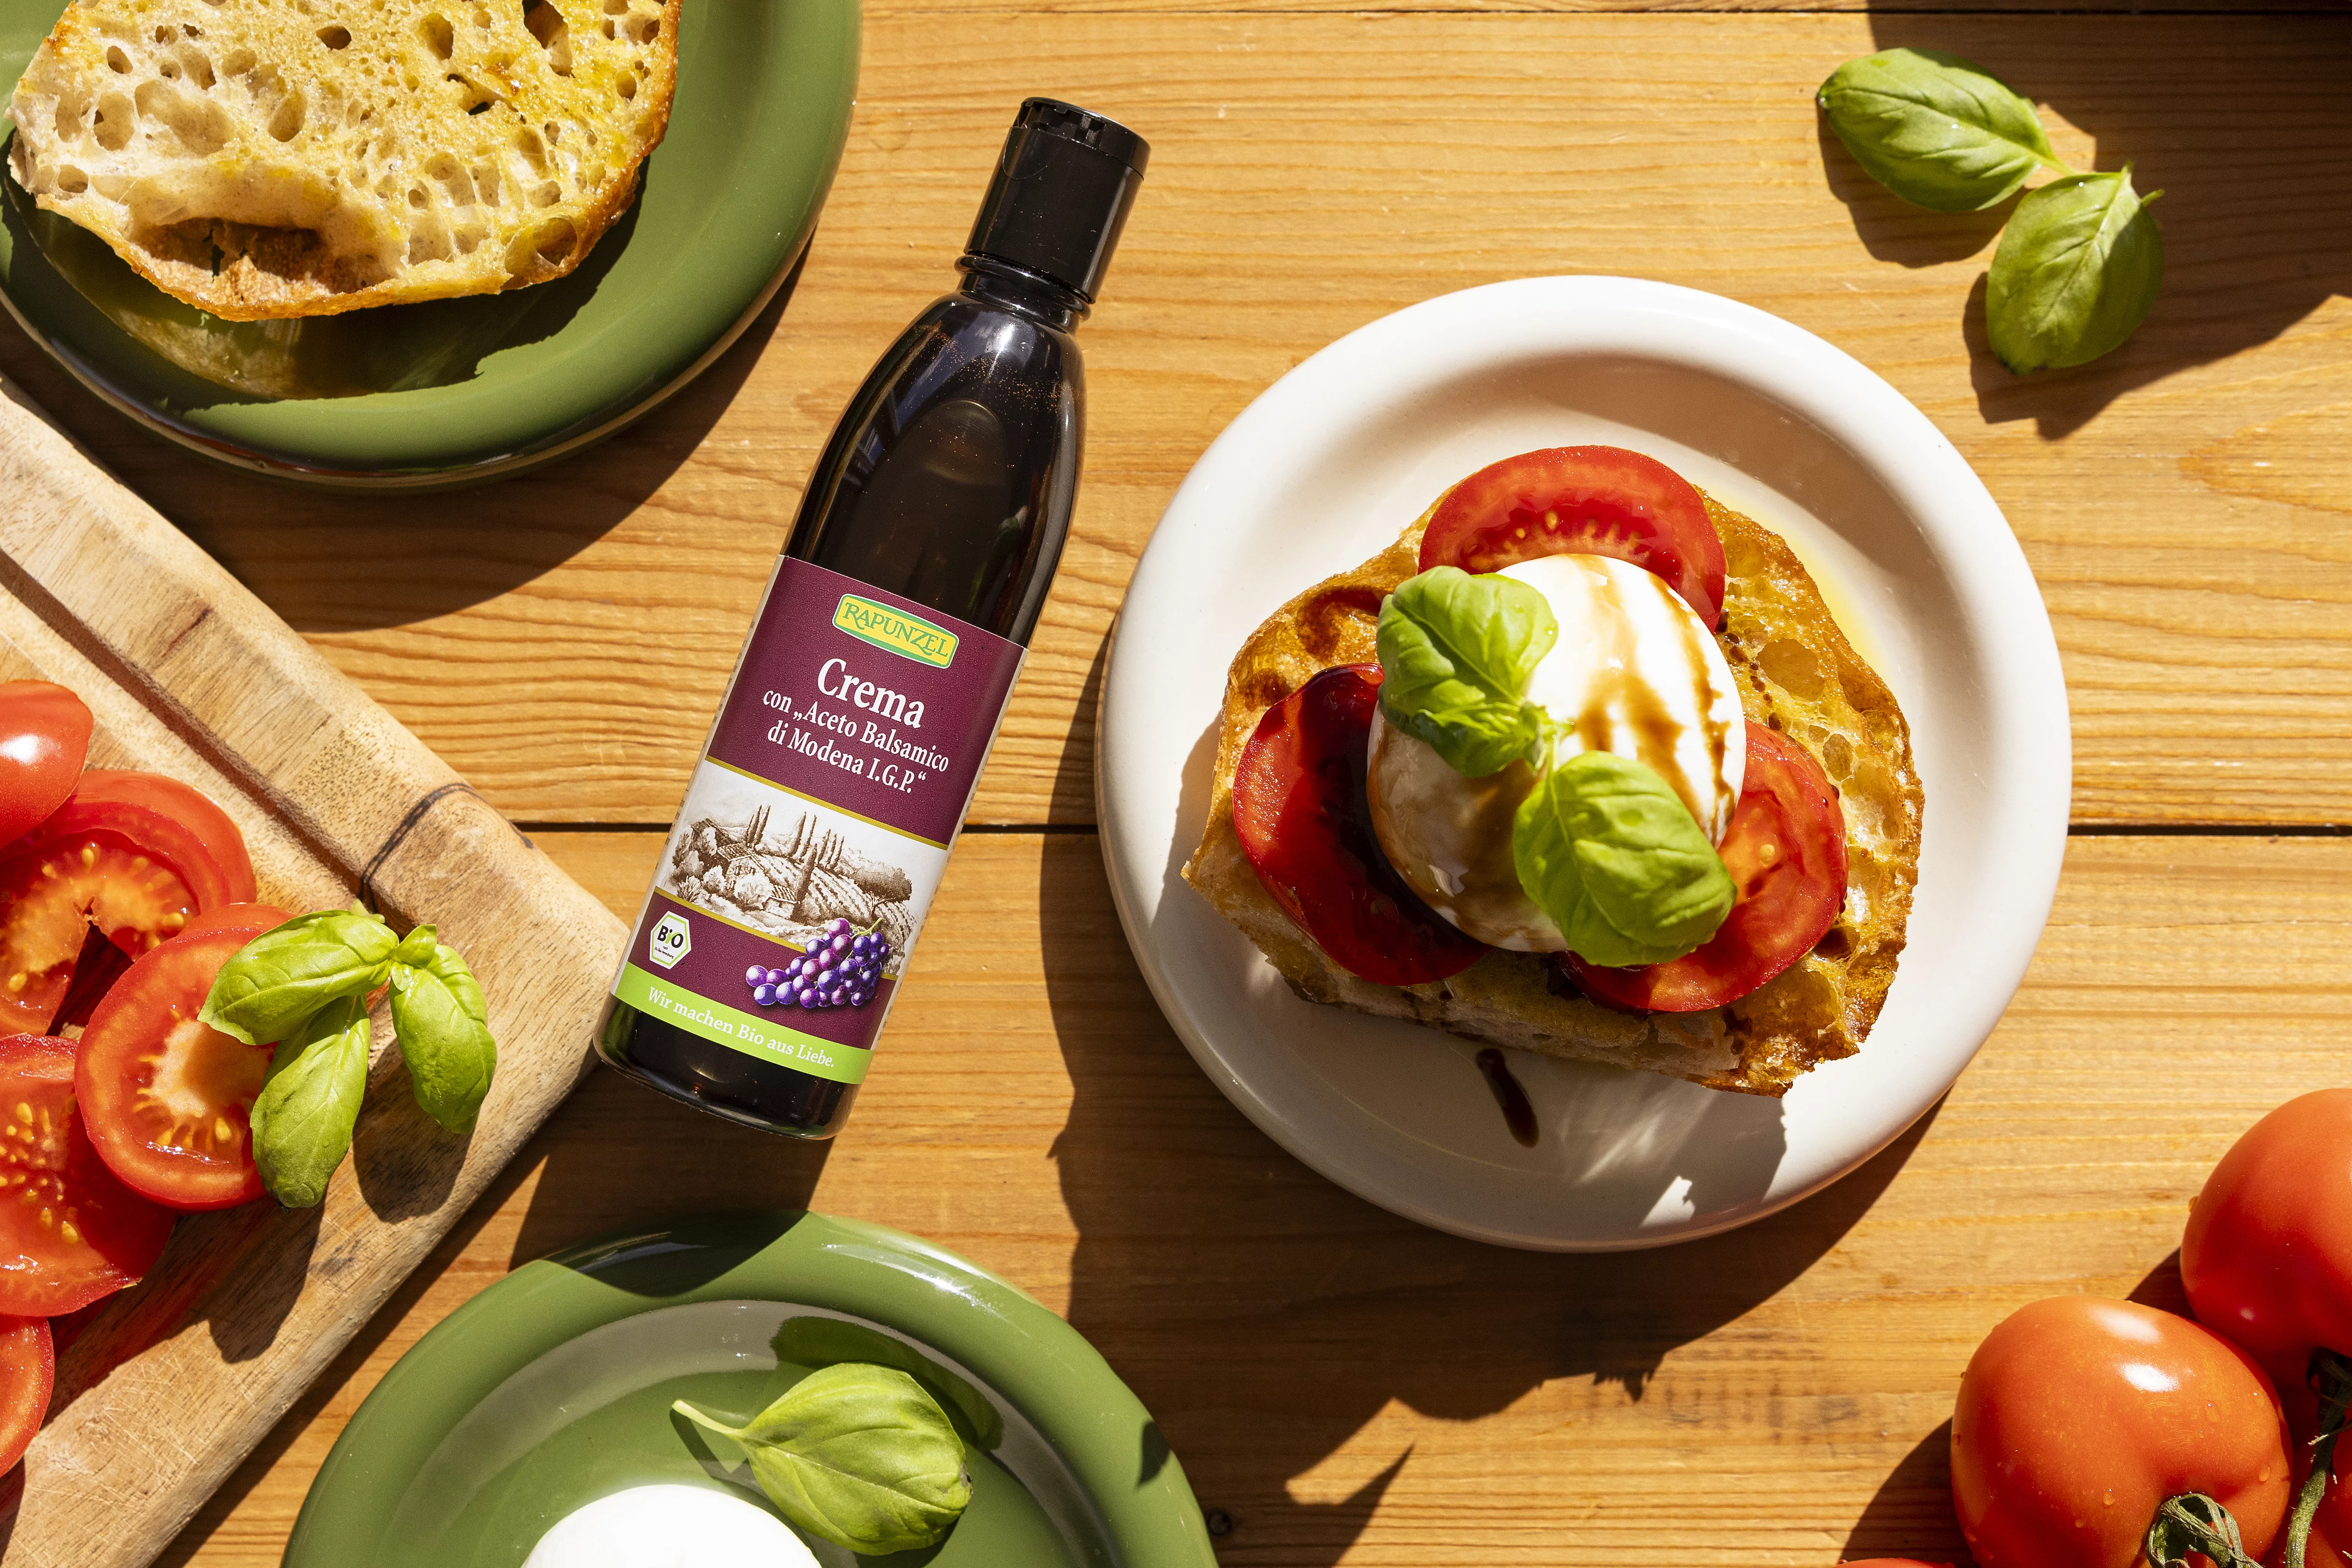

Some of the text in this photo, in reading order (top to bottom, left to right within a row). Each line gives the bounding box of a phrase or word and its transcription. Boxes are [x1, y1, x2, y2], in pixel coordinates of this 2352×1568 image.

[845, 601, 949, 658] RAPUNZEL
[817, 658, 925, 729] Crema
[763, 690, 792, 714] con
[859, 720, 949, 772] Balsamico
[767, 719, 789, 746] di
[786, 727, 864, 776] Modena
[648, 986, 835, 1068] Wir machen Bio aus Liebe.
